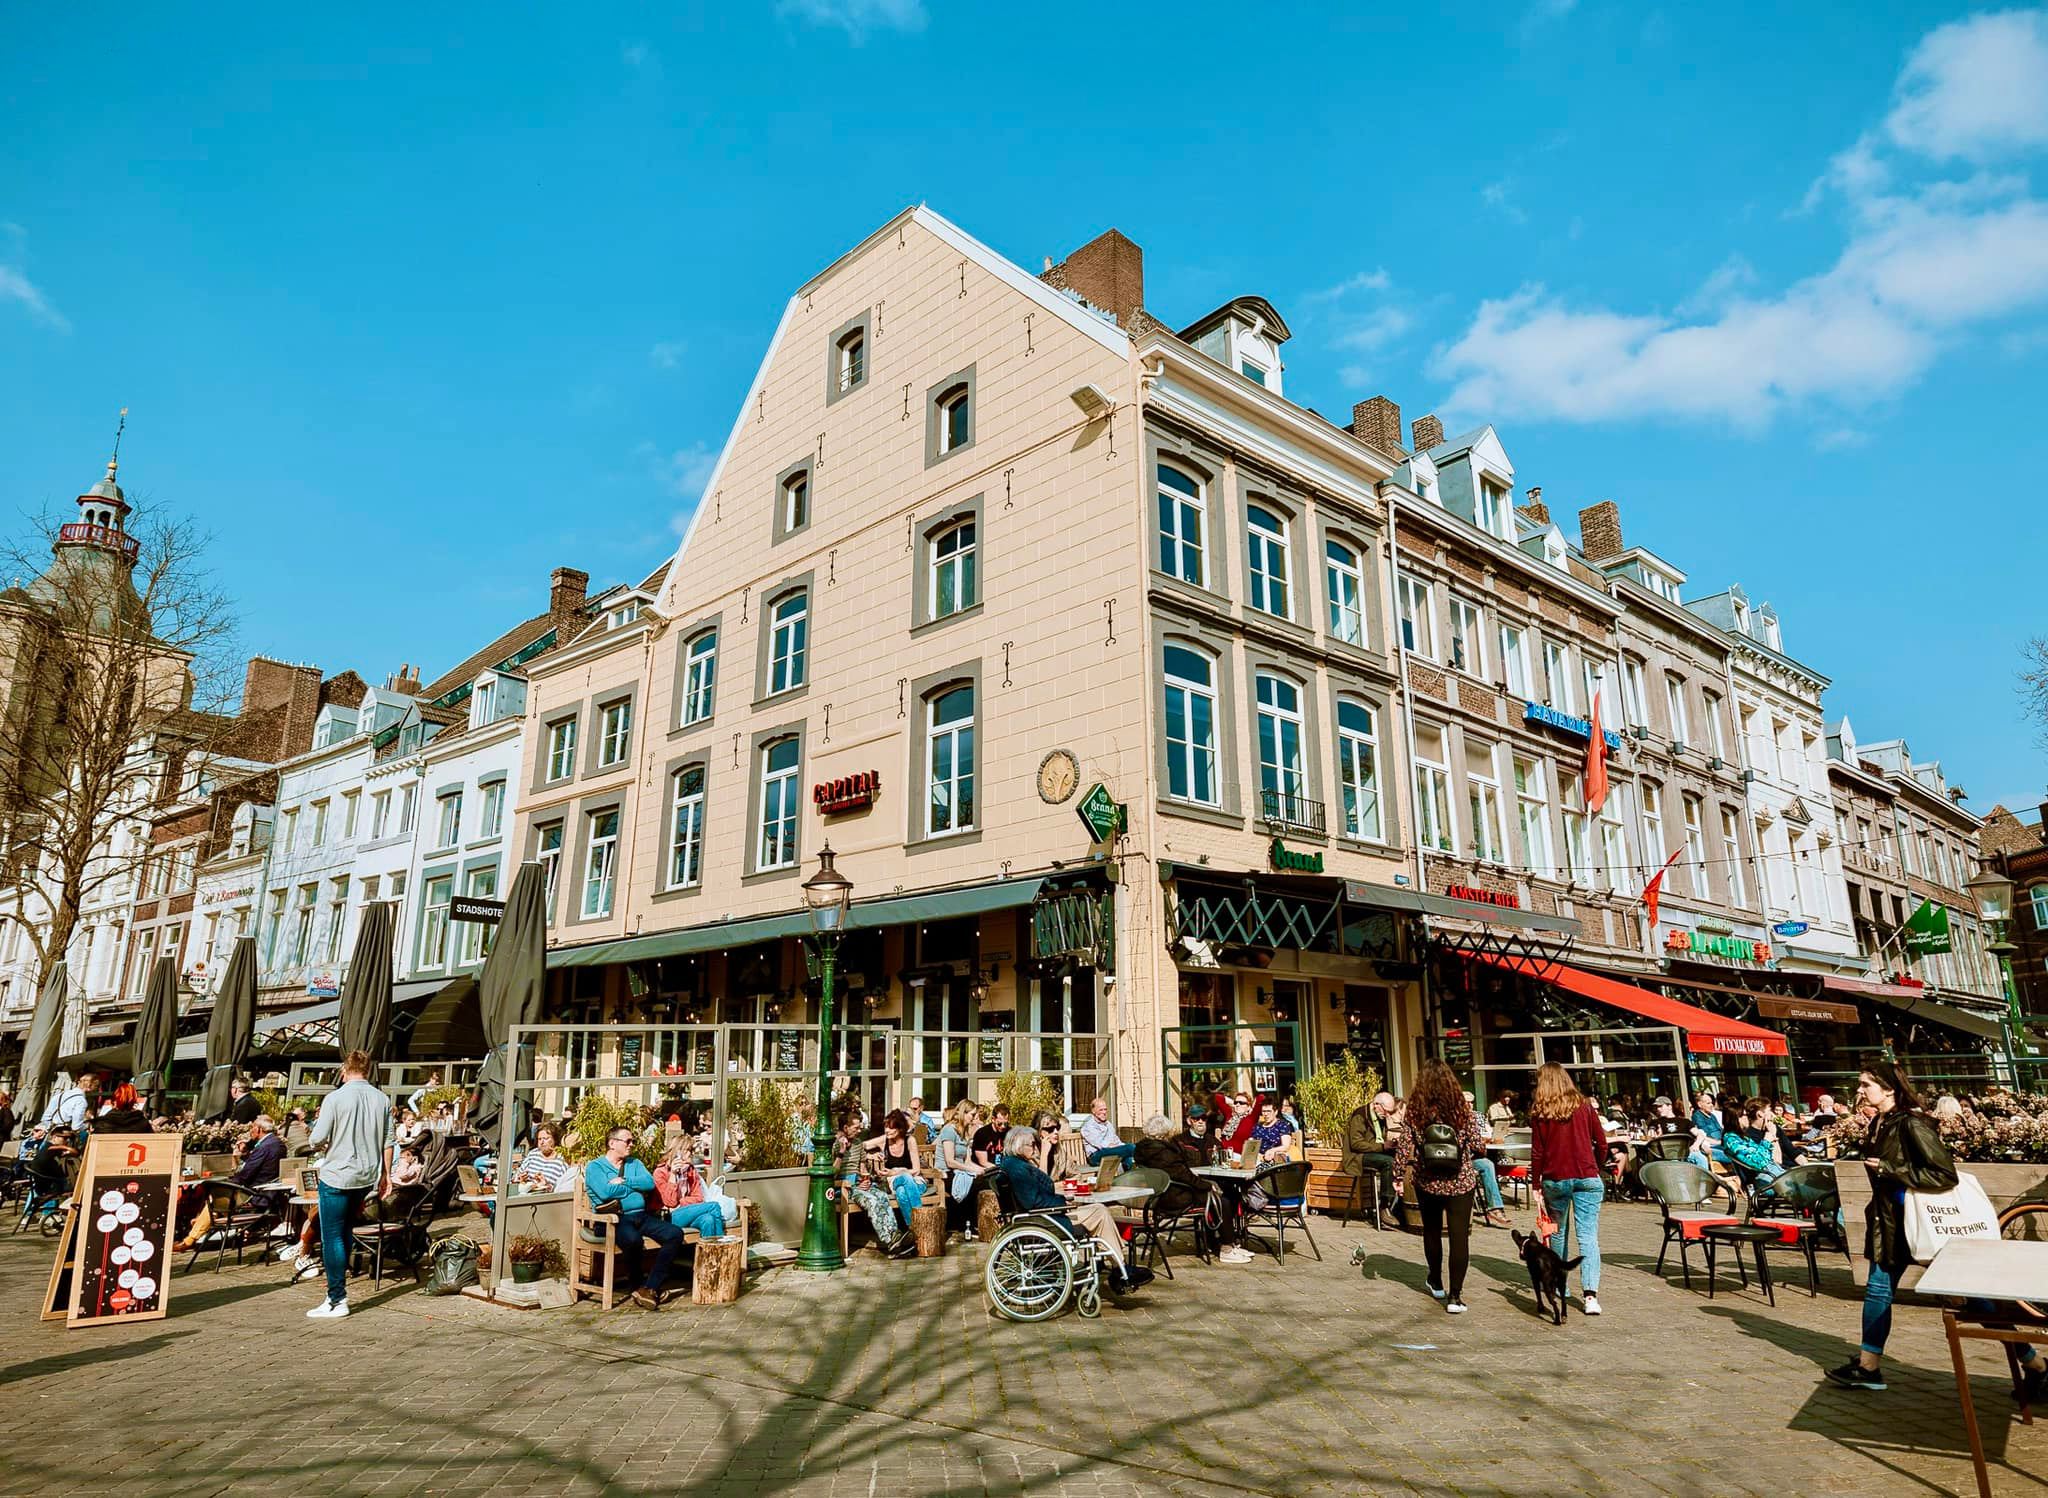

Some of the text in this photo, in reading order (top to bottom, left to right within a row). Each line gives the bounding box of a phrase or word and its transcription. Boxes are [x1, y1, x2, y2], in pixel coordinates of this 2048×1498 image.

[813, 769, 881, 804] CAPITAL
[1090, 799, 1115, 815] Brand
[1271, 837, 1324, 873] Brand
[1777, 926, 1804, 934] Bavaria
[1926, 1205, 1960, 1215] QUEEN
[1930, 1215, 1943, 1224] OF
